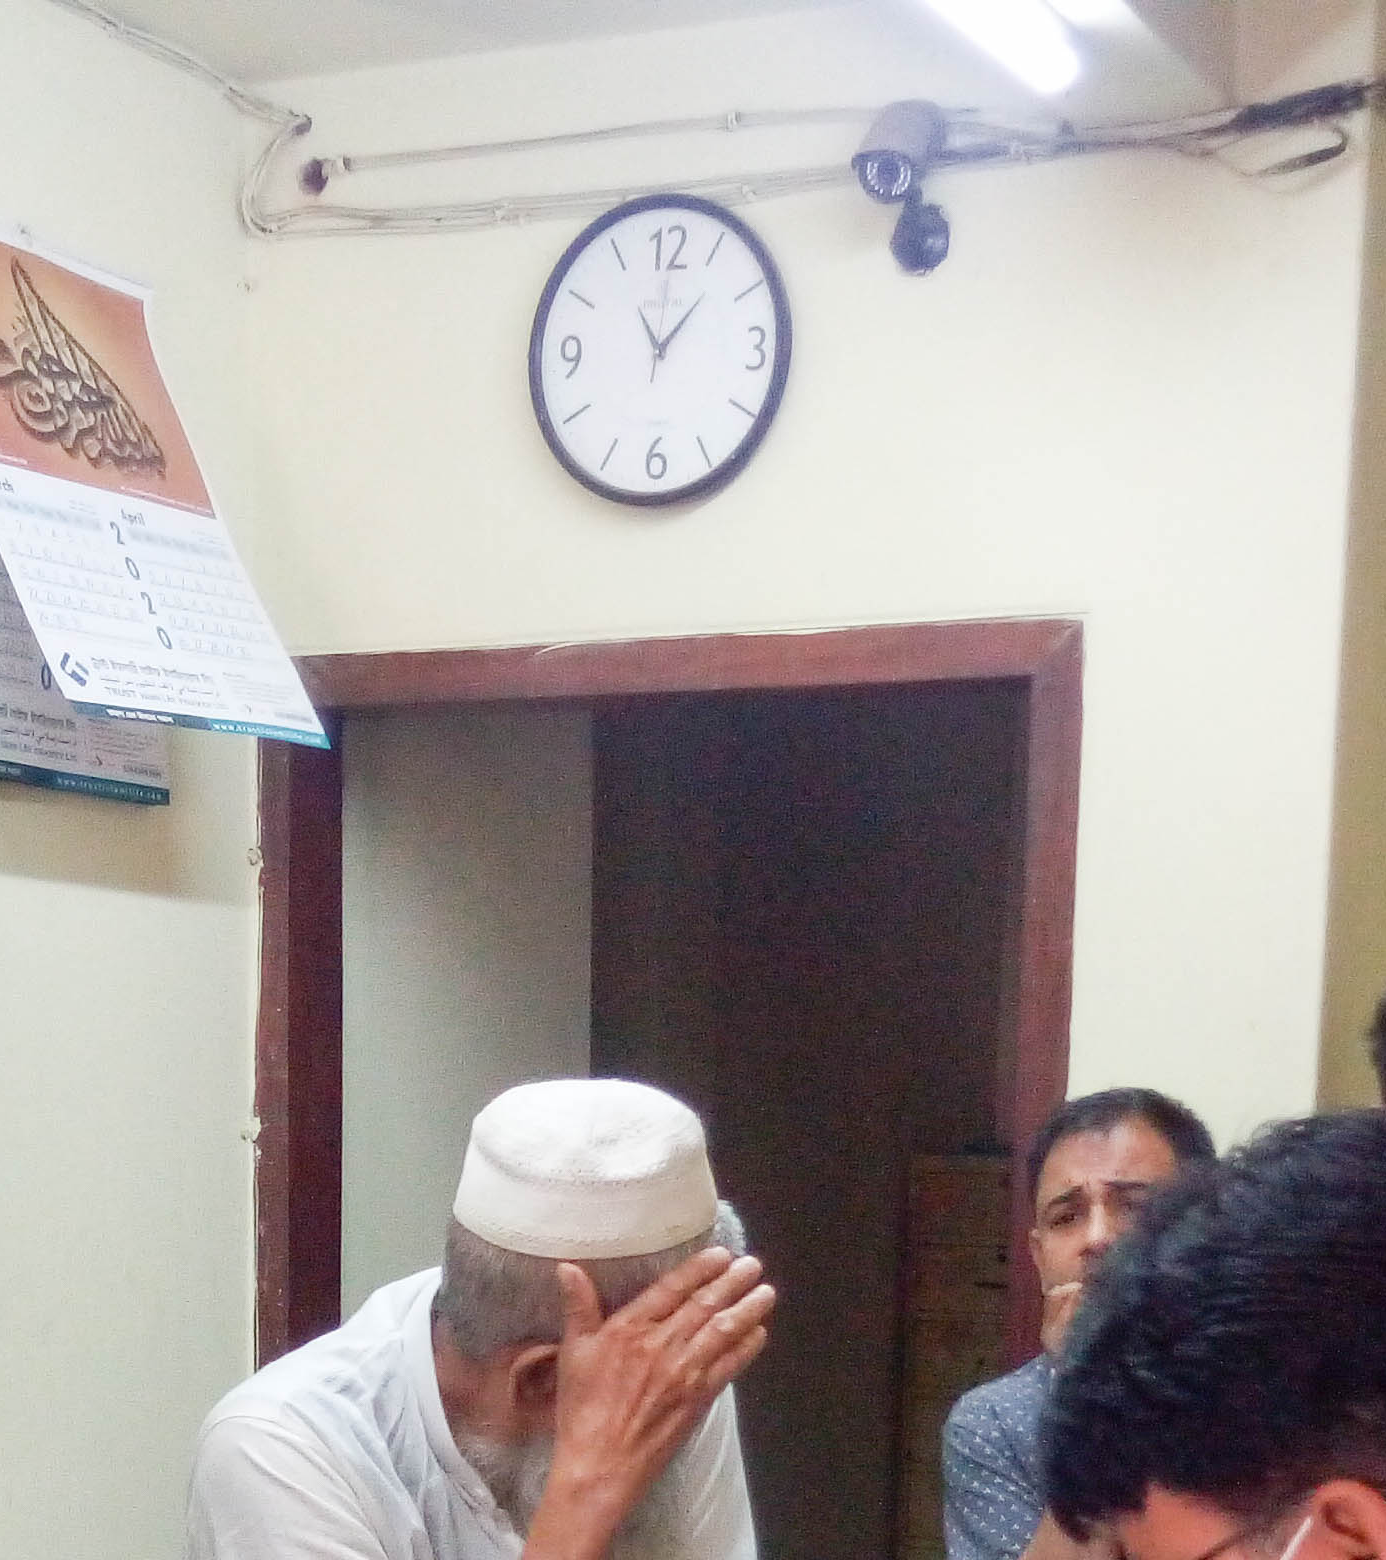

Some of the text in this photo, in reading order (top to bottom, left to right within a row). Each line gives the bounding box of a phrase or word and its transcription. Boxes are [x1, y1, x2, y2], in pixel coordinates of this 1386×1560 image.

[649, 225, 688, 271] 12
[560, 335, 583, 380] 9
[745, 326, 766, 371] 3
[645, 437, 667, 480] 6
